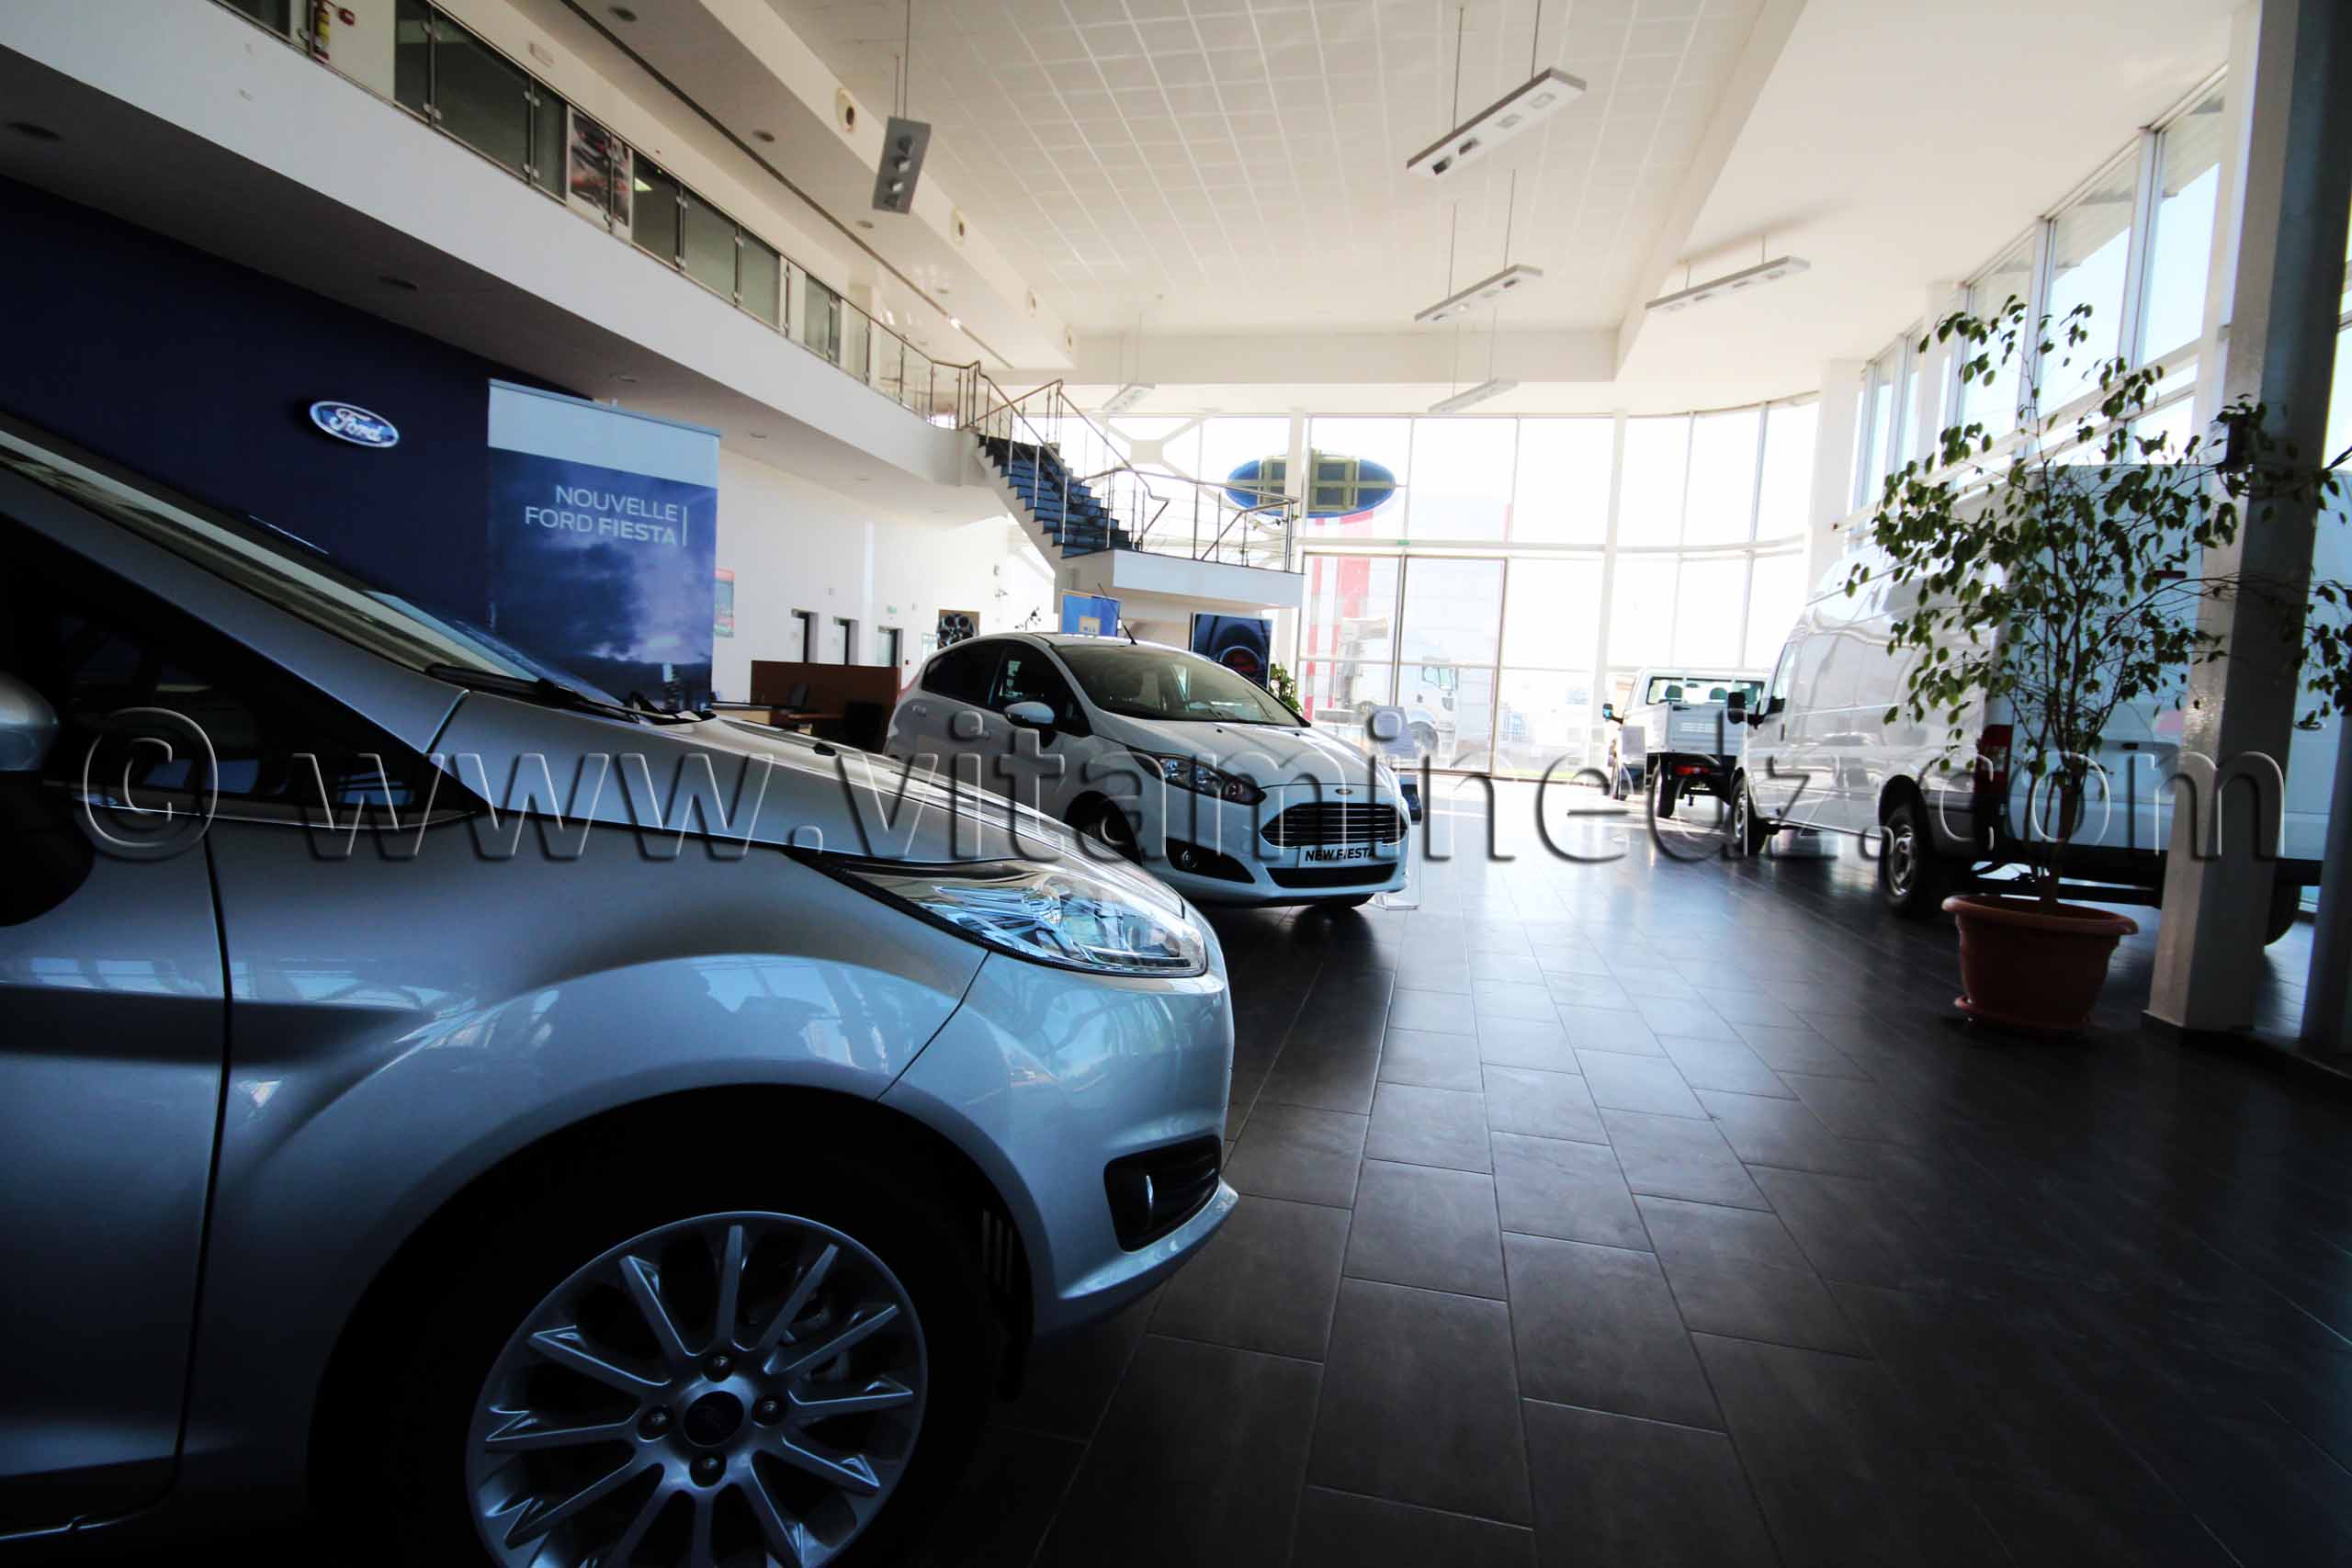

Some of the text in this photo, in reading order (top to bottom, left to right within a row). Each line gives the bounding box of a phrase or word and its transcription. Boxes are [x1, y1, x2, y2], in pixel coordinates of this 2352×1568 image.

[329, 407, 384, 442] Ford
[555, 484, 678, 522] NOUVELLE
[525, 506, 677, 545] FORD FIESTA
[1305, 847, 1375, 862] NEW FIESTA
